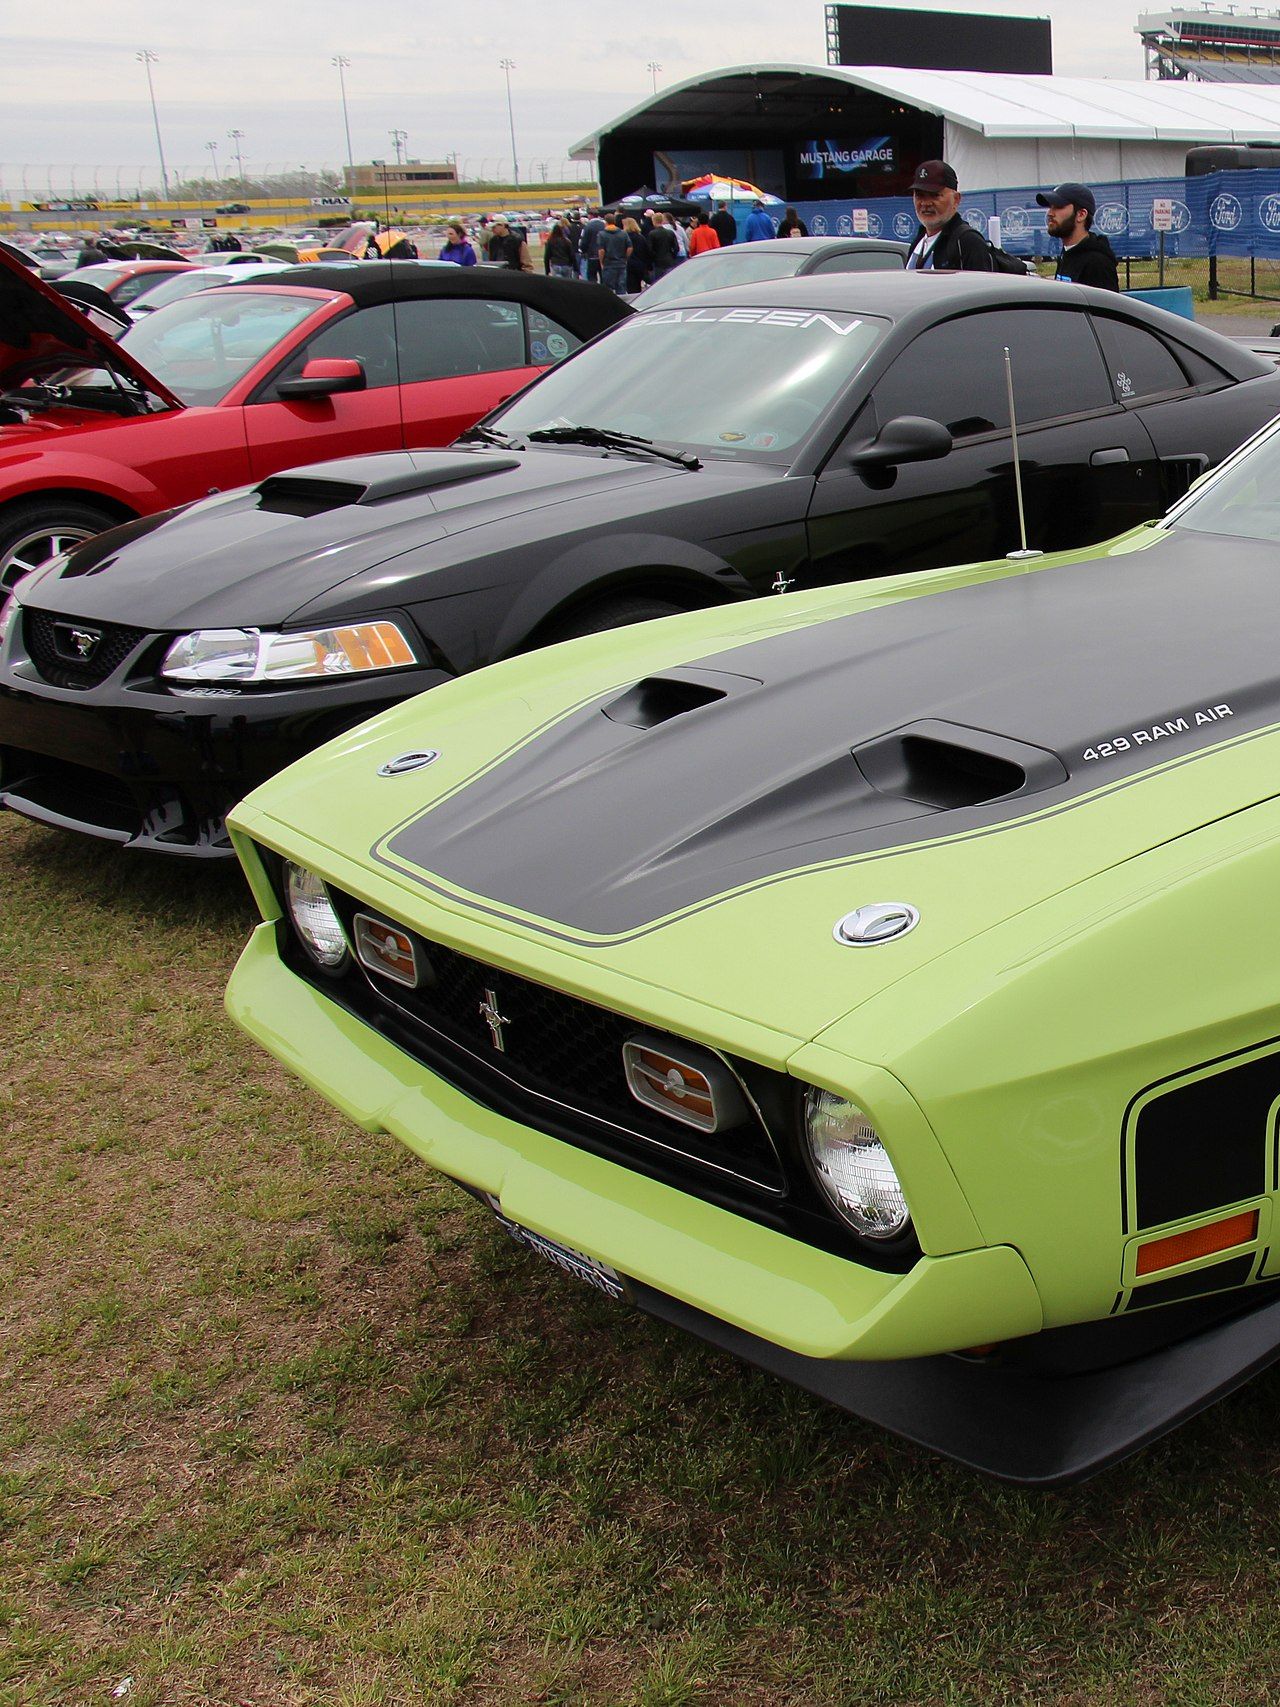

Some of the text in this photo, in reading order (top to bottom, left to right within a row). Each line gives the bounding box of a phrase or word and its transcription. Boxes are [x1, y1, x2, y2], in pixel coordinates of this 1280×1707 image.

[800, 148, 893, 164] MUSTANG GARAGE
[1100, 206, 1124, 230] Ford
[1215, 197, 1238, 226] Ford
[625, 308, 863, 336] SALEEN
[1082, 703, 1234, 761] 429 RAM AIR
[530, 1240, 619, 1299] MUSTANG
